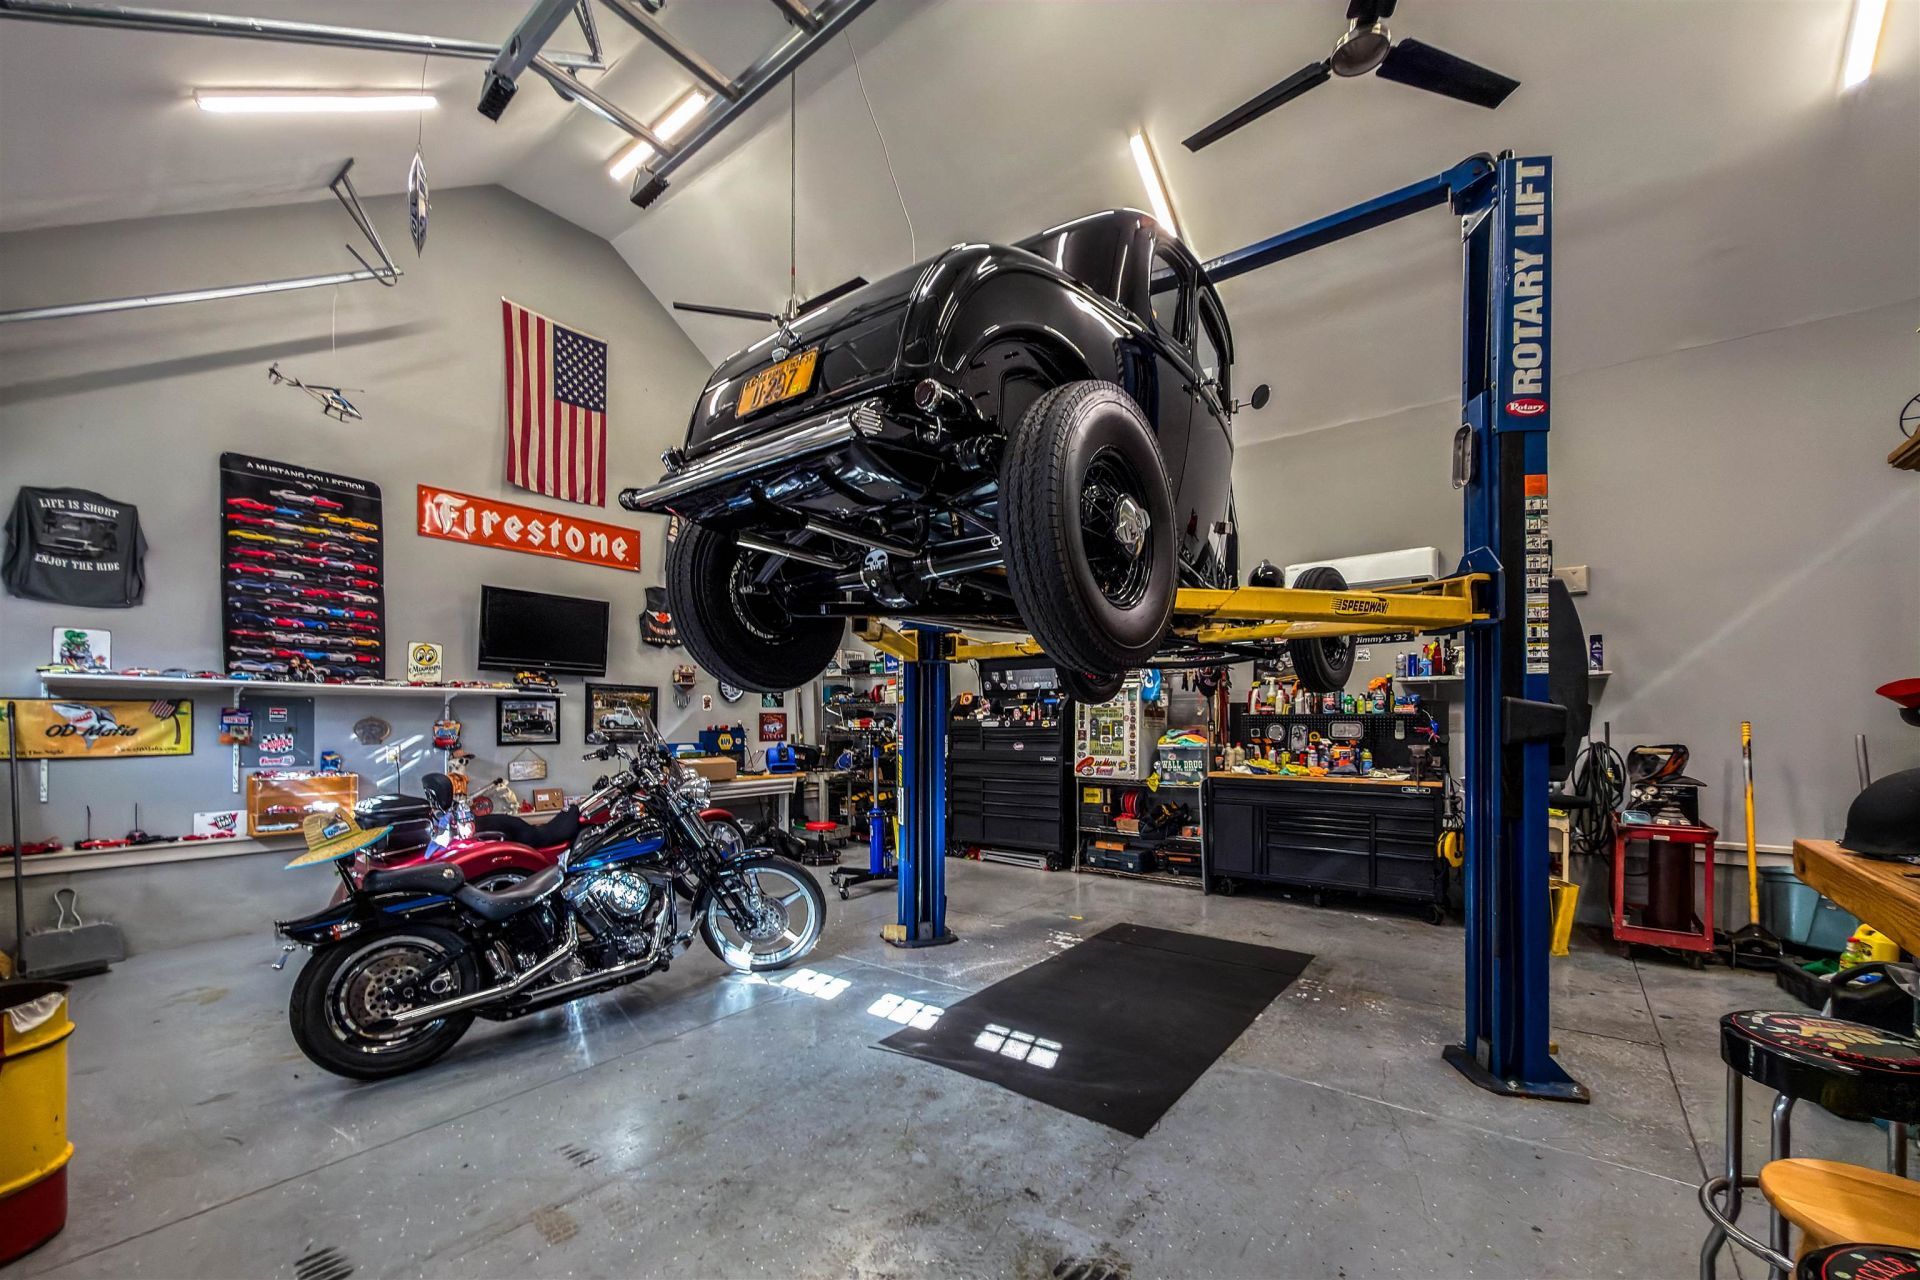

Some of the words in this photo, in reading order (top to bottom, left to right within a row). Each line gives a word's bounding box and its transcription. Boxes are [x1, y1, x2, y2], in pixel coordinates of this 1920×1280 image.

[1514, 160, 1545, 236] LIFT
[1512, 248, 1544, 394] ROTARY
[1510, 402, 1544, 414] Rotary
[256, 463, 305, 479] MUSTANG
[306, 473, 366, 491] COLLECTION
[39, 498, 65, 509] LIFE
[68, 500, 80, 510] IS
[83, 502, 119, 518] SHORT
[424, 493, 628, 561] Firestone
[34, 553, 68, 567] ENJOY
[71, 560, 93, 571] THE
[97, 562, 120, 571] RIDE
[1341, 599, 1388, 613] SPEEDWAY
[1356, 635, 1391, 643] Jimmy's
[45, 725, 76, 737] OD
[82, 724, 140, 737] Mafia
[1162, 760, 1182, 769] WALL
[1183, 760, 1203, 769] DRUG
